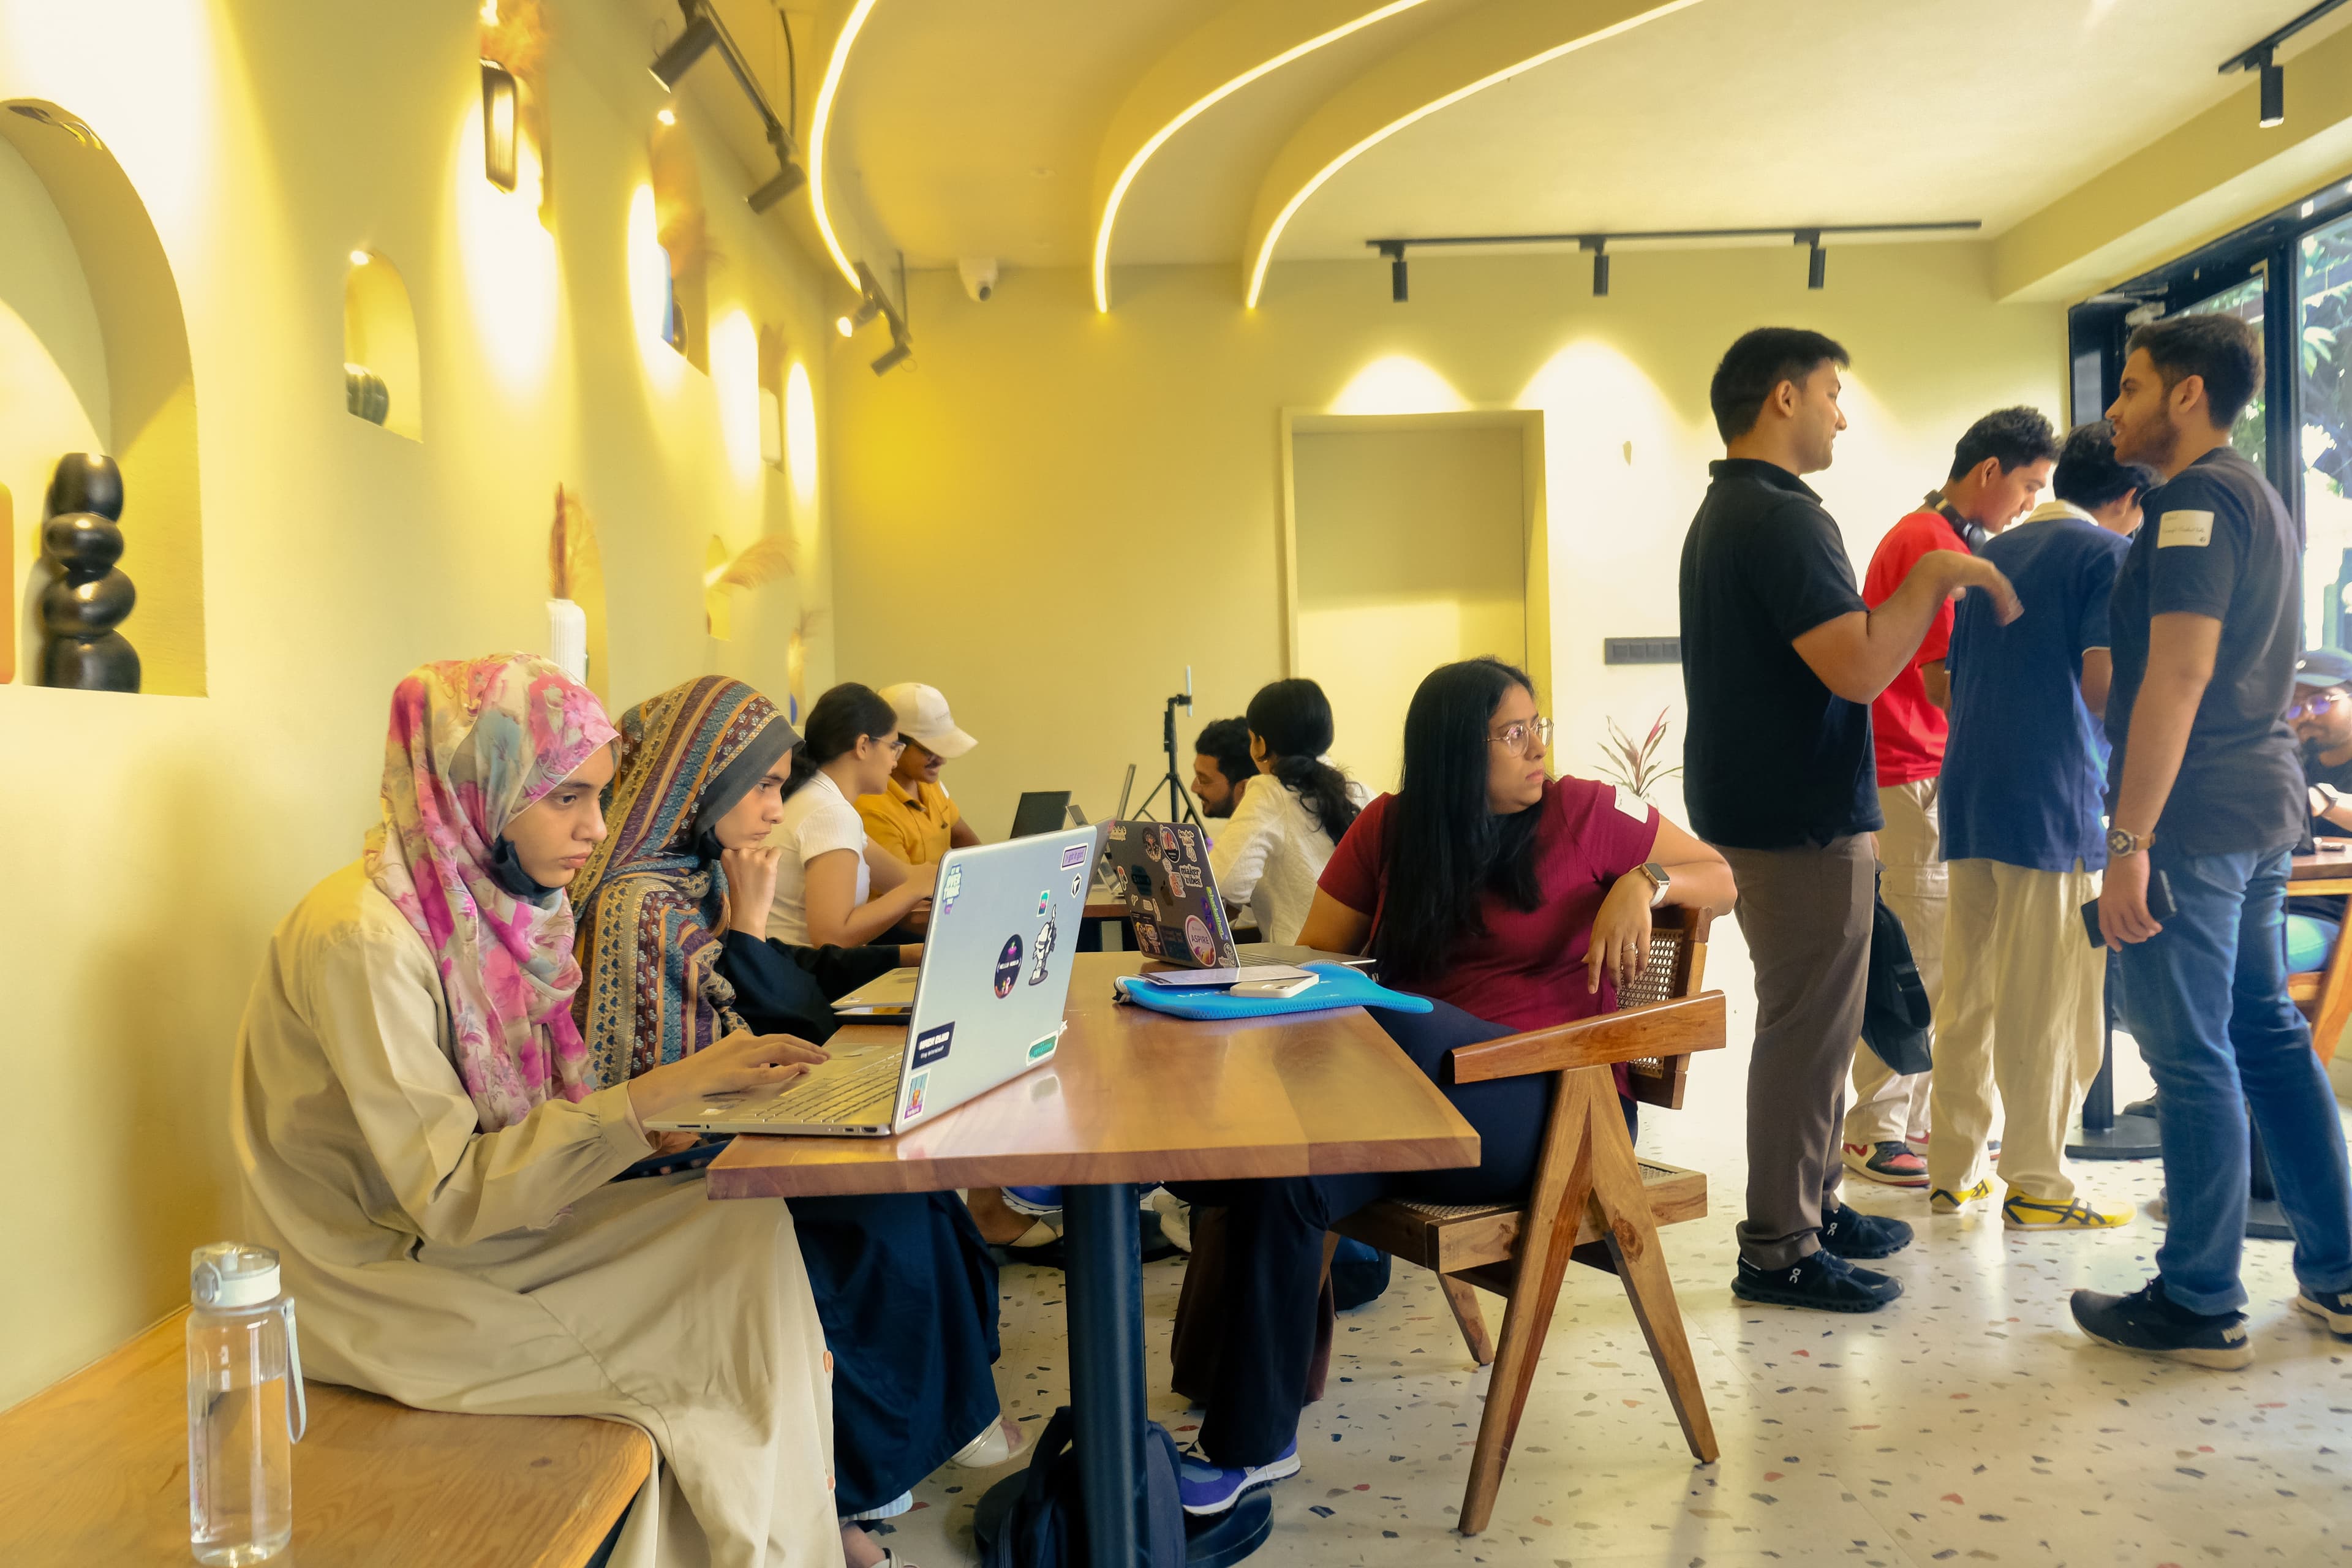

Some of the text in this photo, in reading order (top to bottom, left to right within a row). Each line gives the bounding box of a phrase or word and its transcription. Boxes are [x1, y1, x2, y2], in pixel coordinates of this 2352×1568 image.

[1181, 865, 1200, 876] maker
[1185, 875, 1201, 885] vibes
[1191, 935, 1210, 944] ASPIRE
